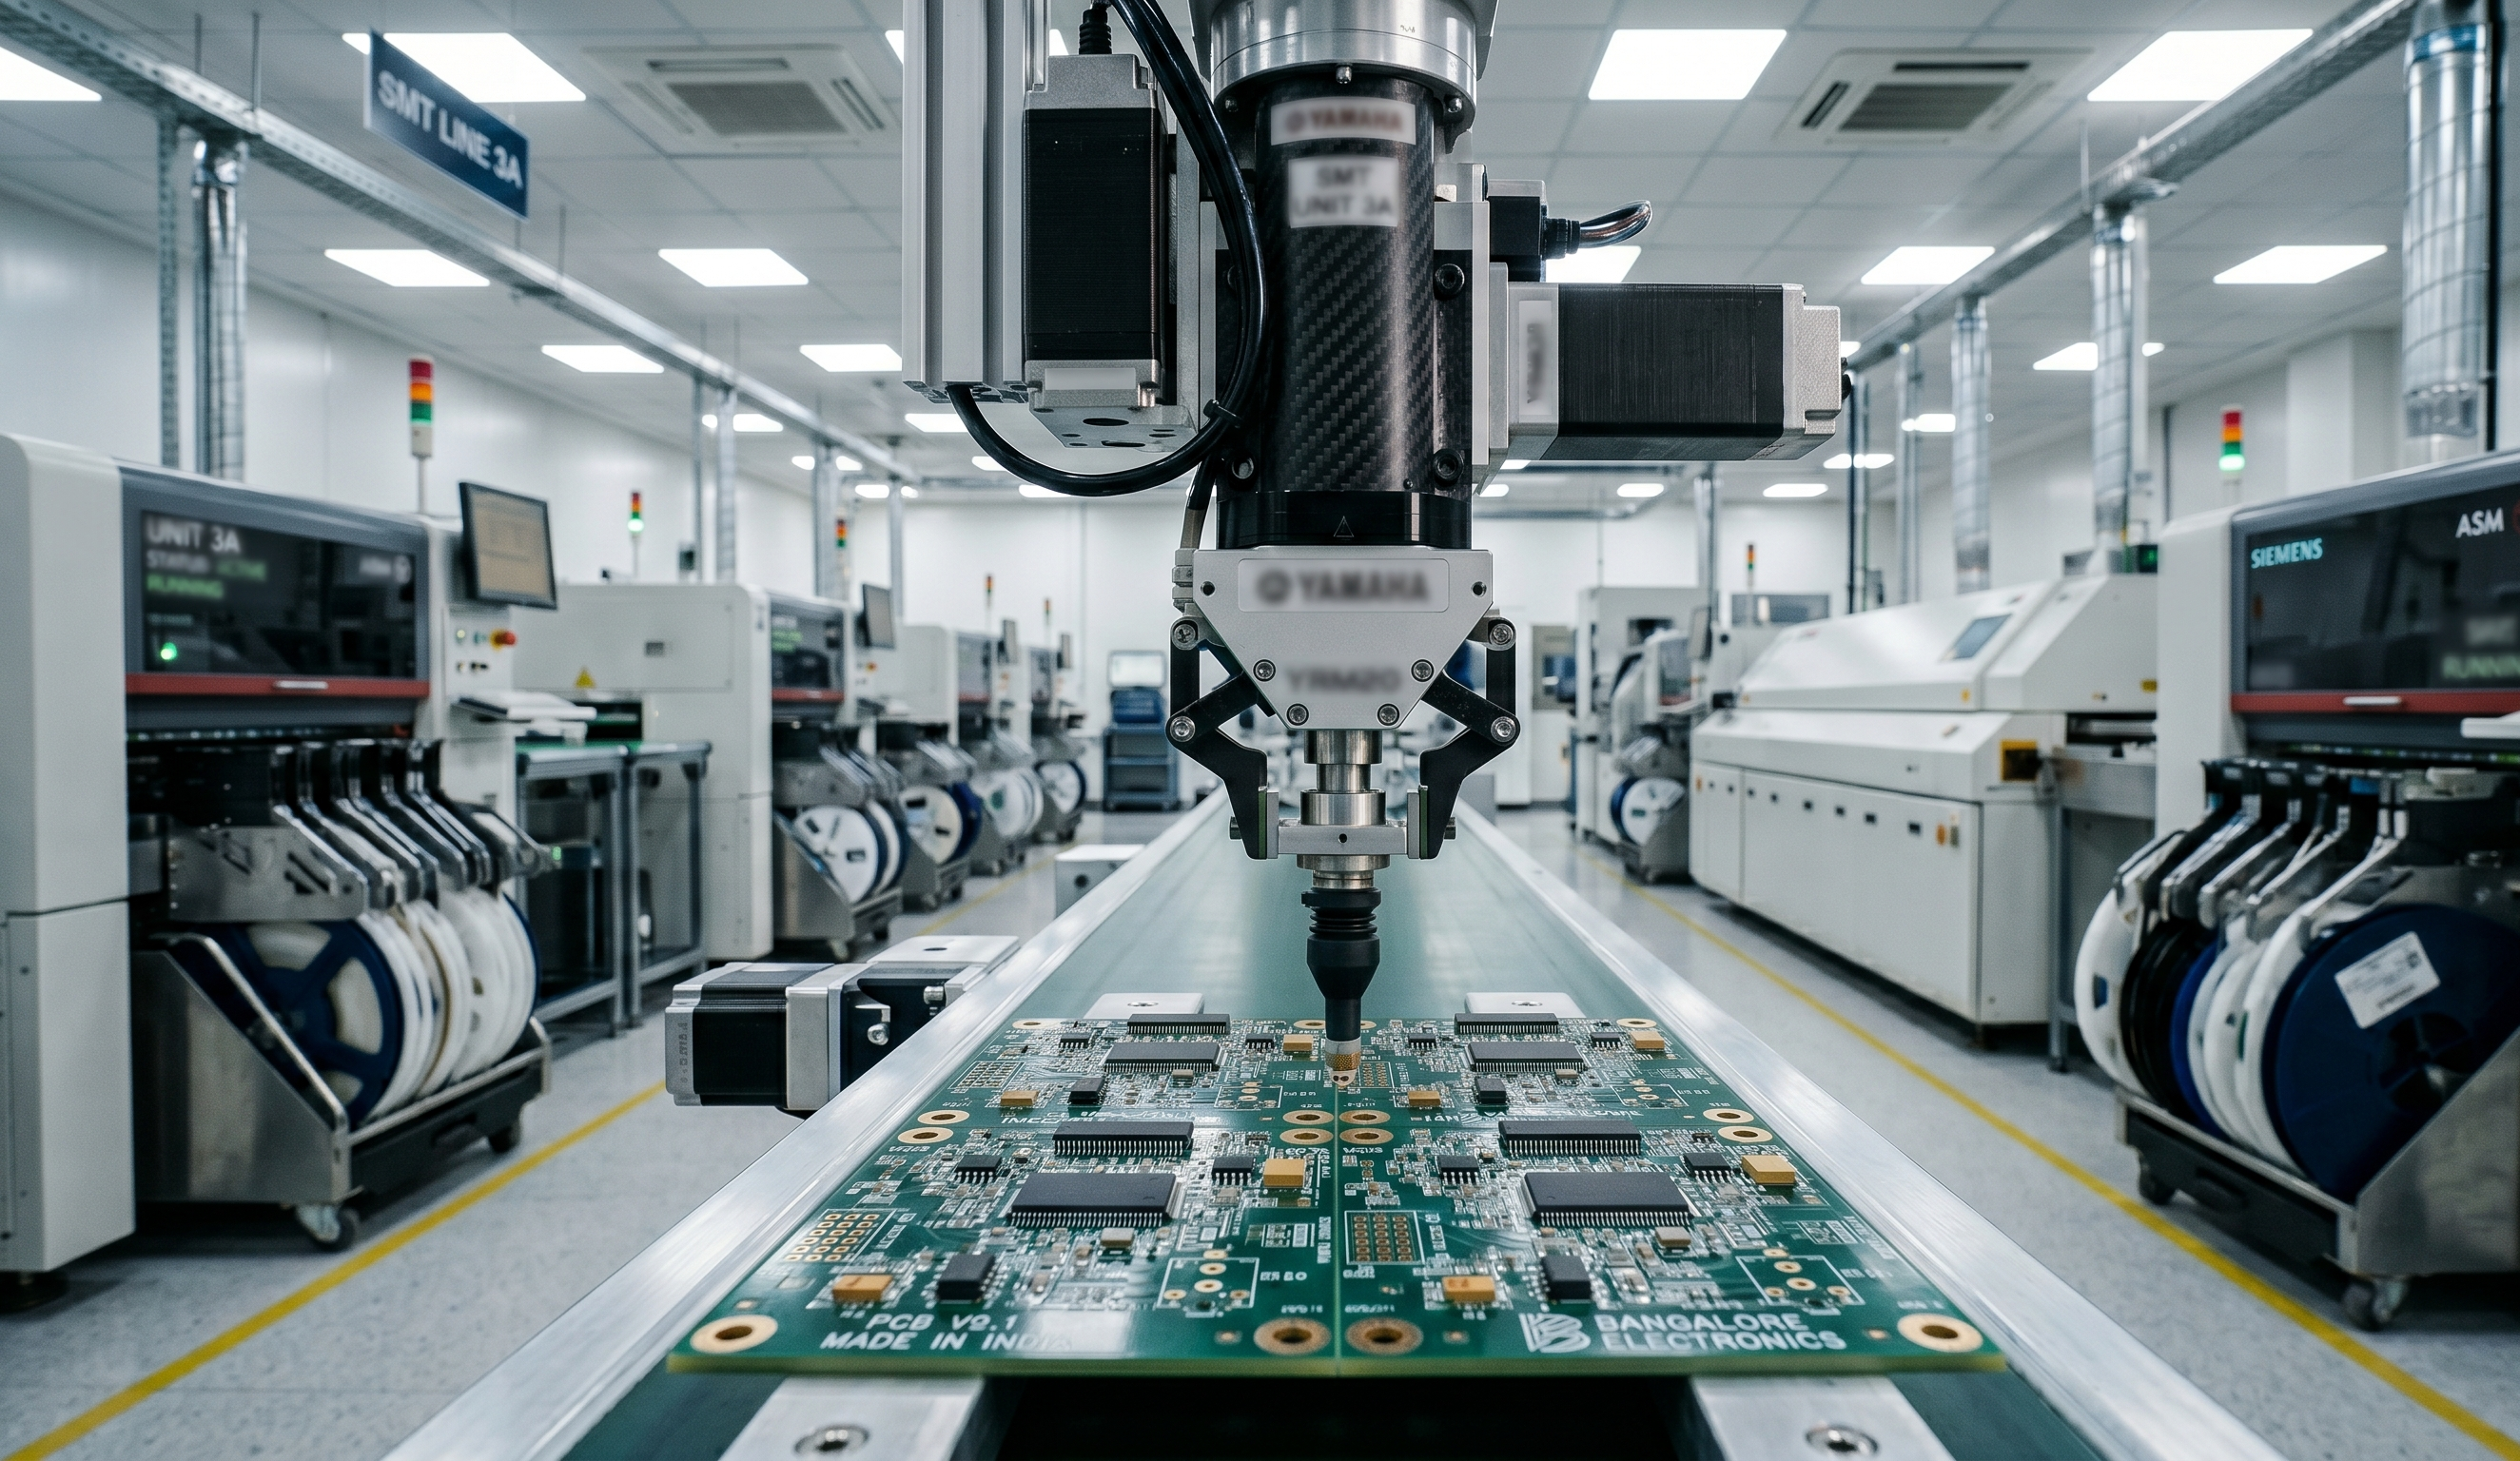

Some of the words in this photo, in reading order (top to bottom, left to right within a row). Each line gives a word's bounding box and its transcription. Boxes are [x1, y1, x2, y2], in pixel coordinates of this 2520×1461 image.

[378, 69, 437, 133] SMT
[438, 107, 492, 170] LINE
[492, 145, 522, 189] 3A
[147, 516, 204, 549] UNIT
[210, 524, 242, 554] 3A
[2455, 506, 2505, 539] ASM
[2251, 537, 2323, 569] SIEMENS
[865, 1314, 935, 1332] PCB
[1593, 1314, 1809, 1332] BANGALORE
[819, 1332, 918, 1351] MADE
[929, 1332, 968, 1351] IN
[1602, 1332, 1847, 1351] ELECTRONICS
